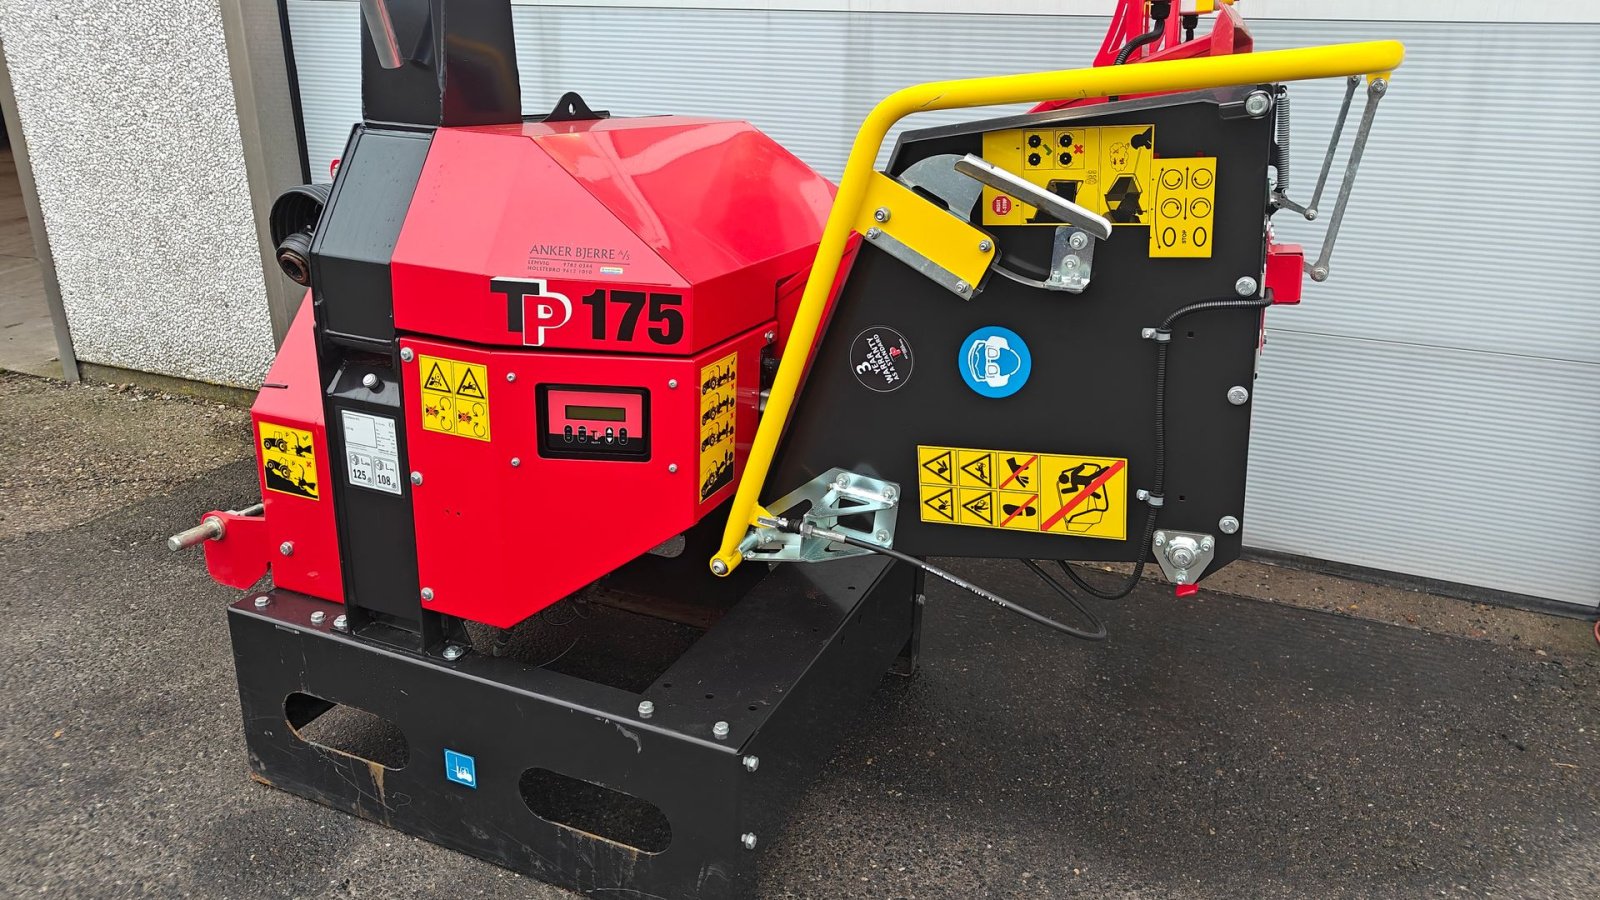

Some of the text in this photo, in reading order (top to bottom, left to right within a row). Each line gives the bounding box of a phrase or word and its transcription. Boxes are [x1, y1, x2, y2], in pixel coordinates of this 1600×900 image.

[529, 244, 572, 257] ANKER
[575, 247, 616, 259] BJERRE
[490, 276, 684, 347] TP 175
[873, 334, 892, 367] STANDARD
[856, 361, 871, 375] 3
[866, 337, 894, 384] WARRANTY
[866, 352, 880, 375] YEAR
[892, 371, 900, 380] AS
[353, 469, 367, 481] 125
[377, 474, 391, 486] 108
